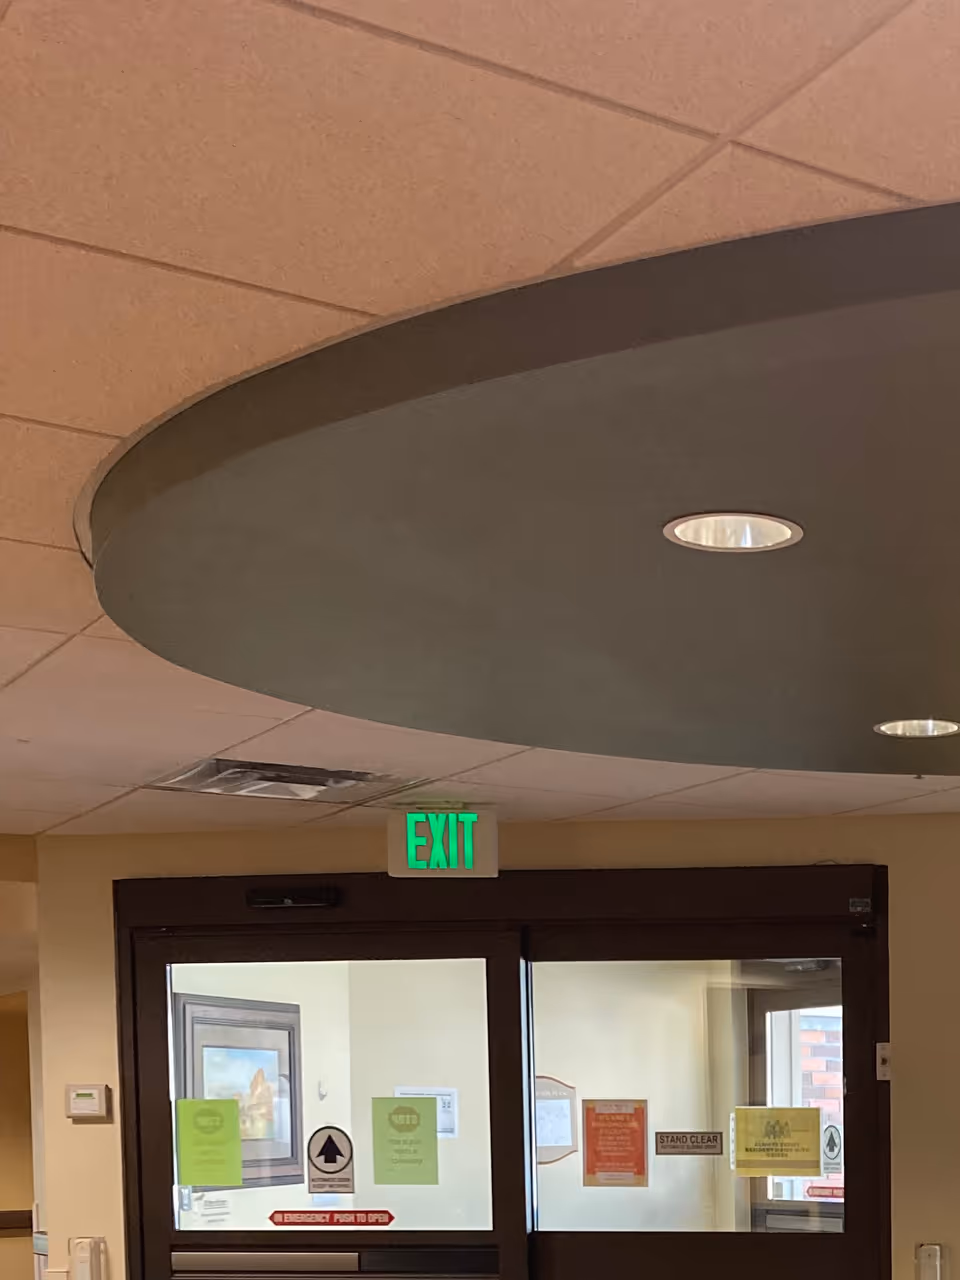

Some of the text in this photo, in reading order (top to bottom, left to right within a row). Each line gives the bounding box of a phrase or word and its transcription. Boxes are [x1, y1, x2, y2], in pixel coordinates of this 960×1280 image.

[406, 812, 478, 869] EXIT
[659, 1135, 718, 1144] STAND CLEAR
[284, 1213, 330, 1222] EMERGENCY
[333, 1213, 355, 1222] PUSH
[356, 1213, 366, 1222] TO
[367, 1213, 389, 1222] OPEN
